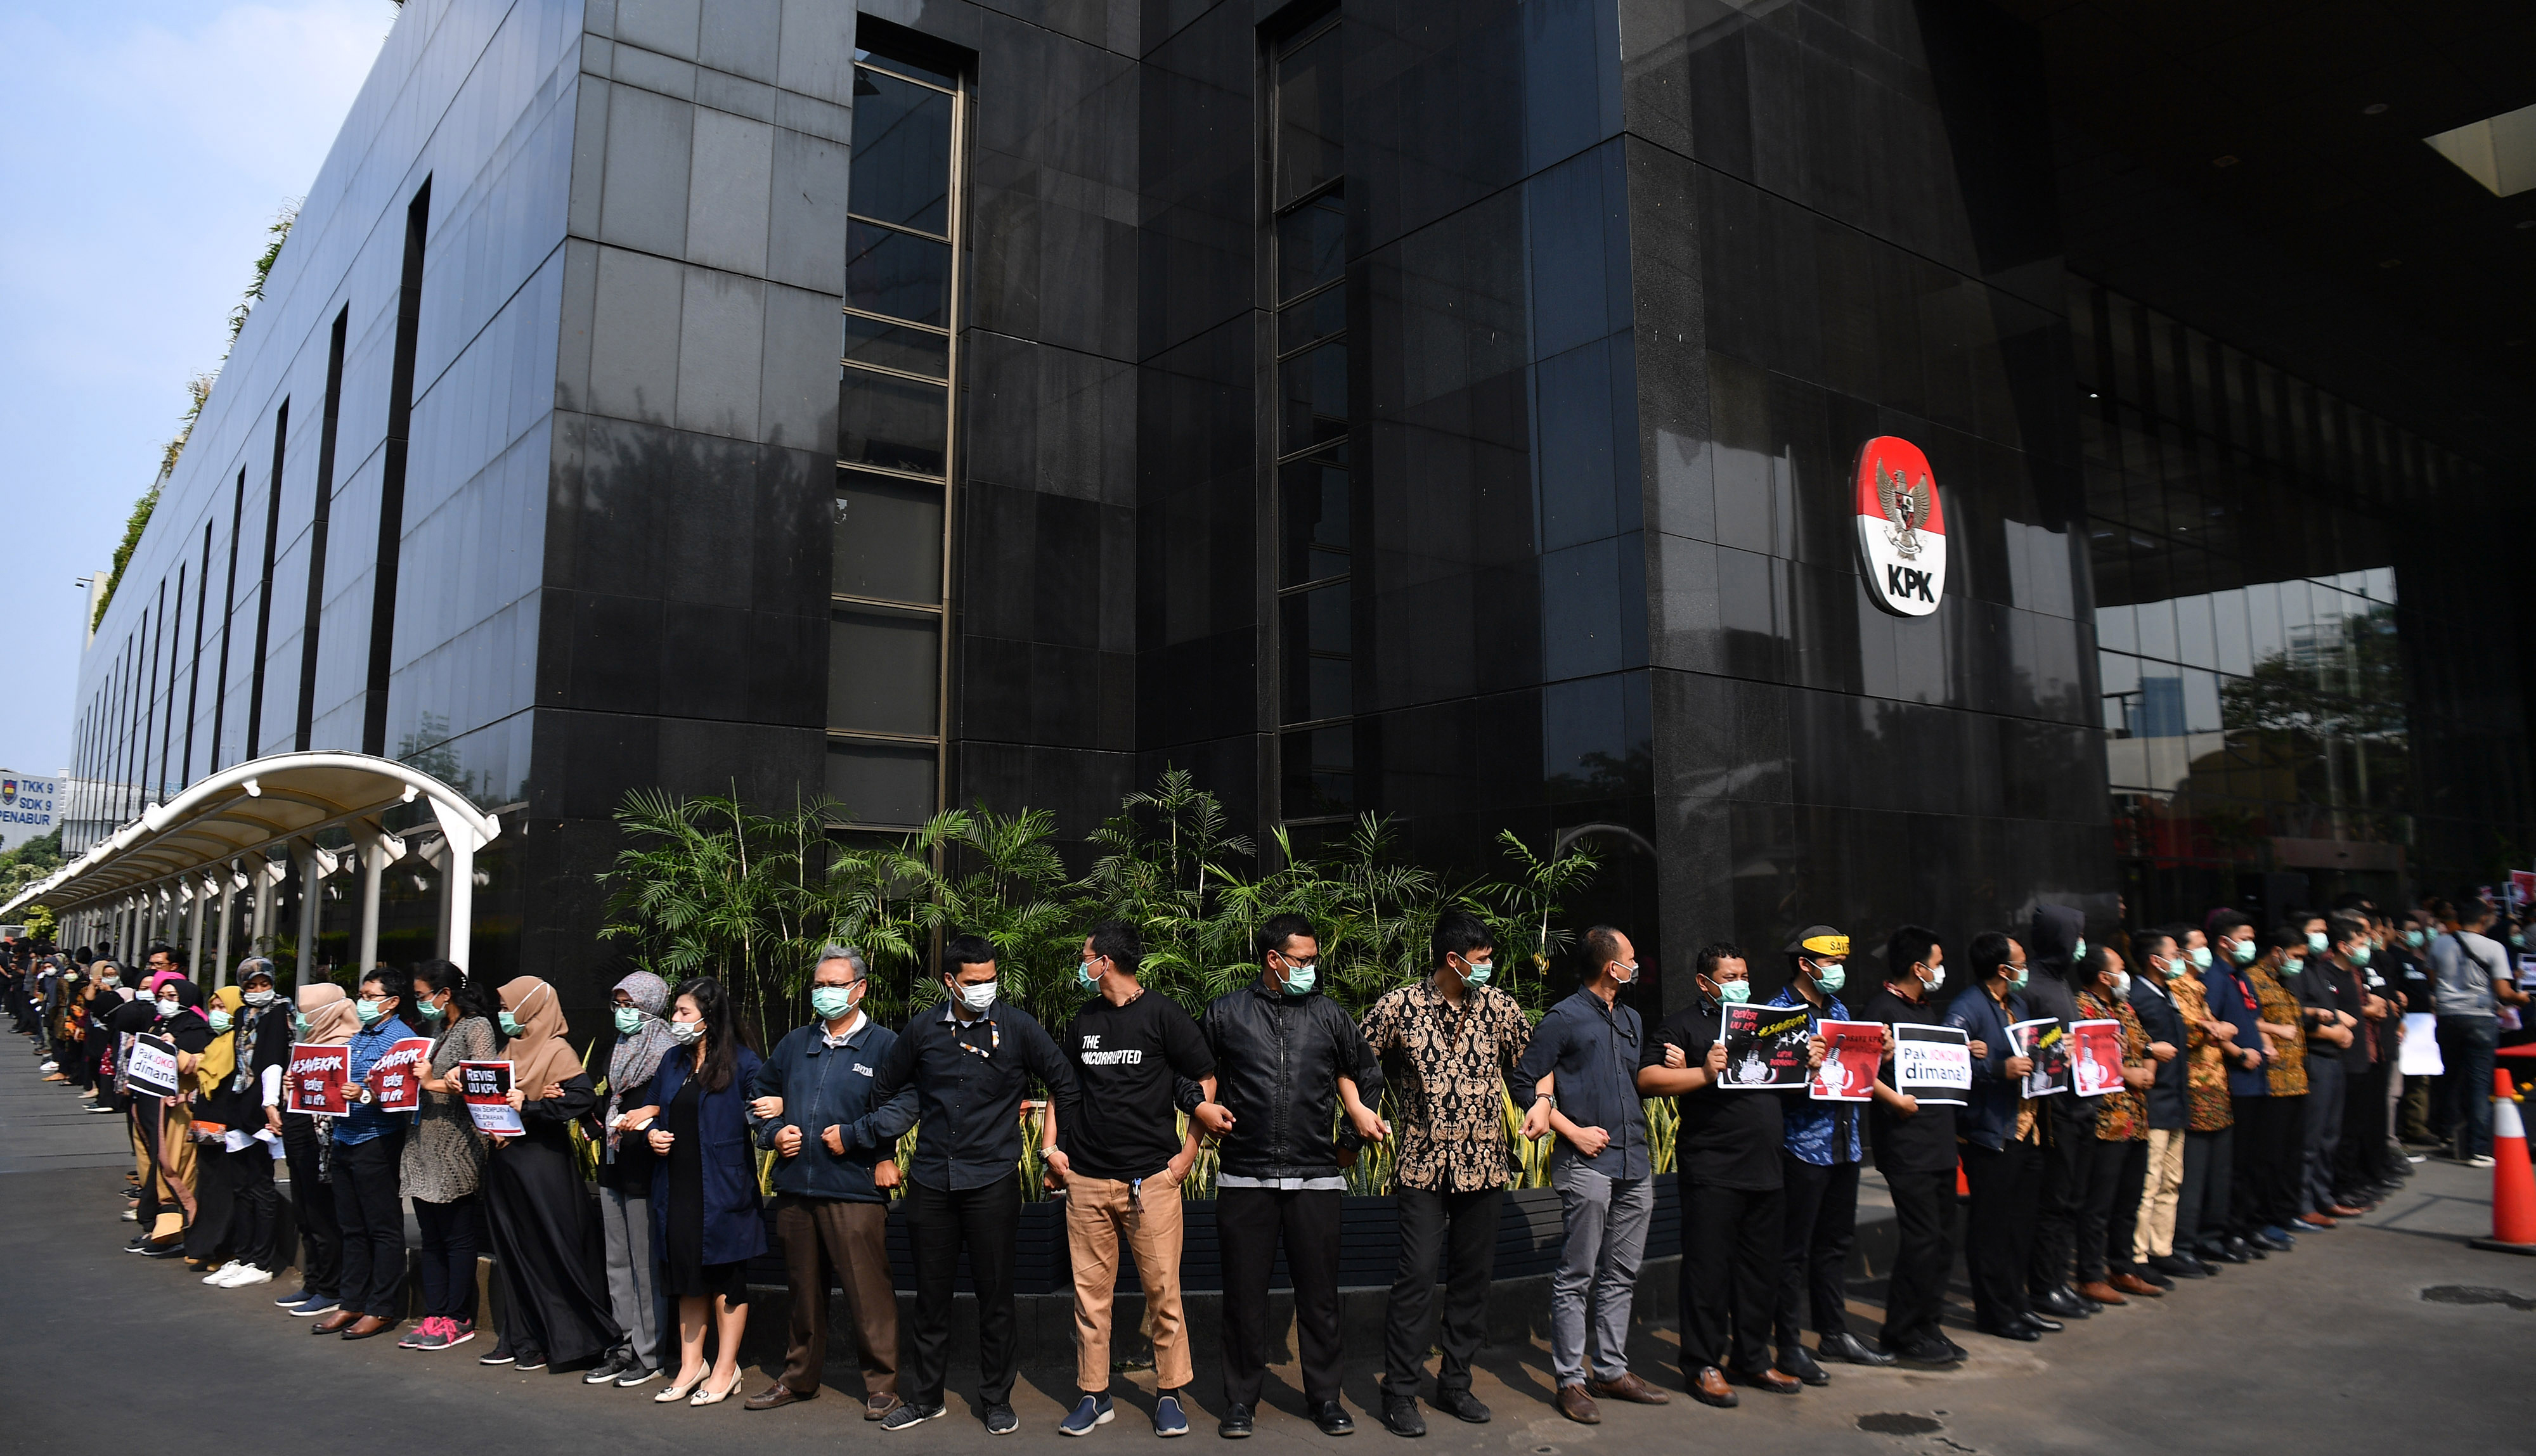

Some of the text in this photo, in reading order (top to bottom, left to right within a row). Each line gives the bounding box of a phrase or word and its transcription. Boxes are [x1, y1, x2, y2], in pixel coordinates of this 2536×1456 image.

[1887, 564, 1935, 603] KPK
[22, 780, 53, 794] TKK 9
[19, 797, 51, 811] SDK 9
[1082, 1035, 1101, 1049] THE
[1905, 1048, 1927, 1060] Pak
[291, 1055, 343, 1076] #SAVEKPK
[466, 1068, 496, 1081] REVISI
[468, 1083, 500, 1093] UU KPK
[313, 1094, 327, 1106] KPK
[389, 1089, 404, 1102] KPK
